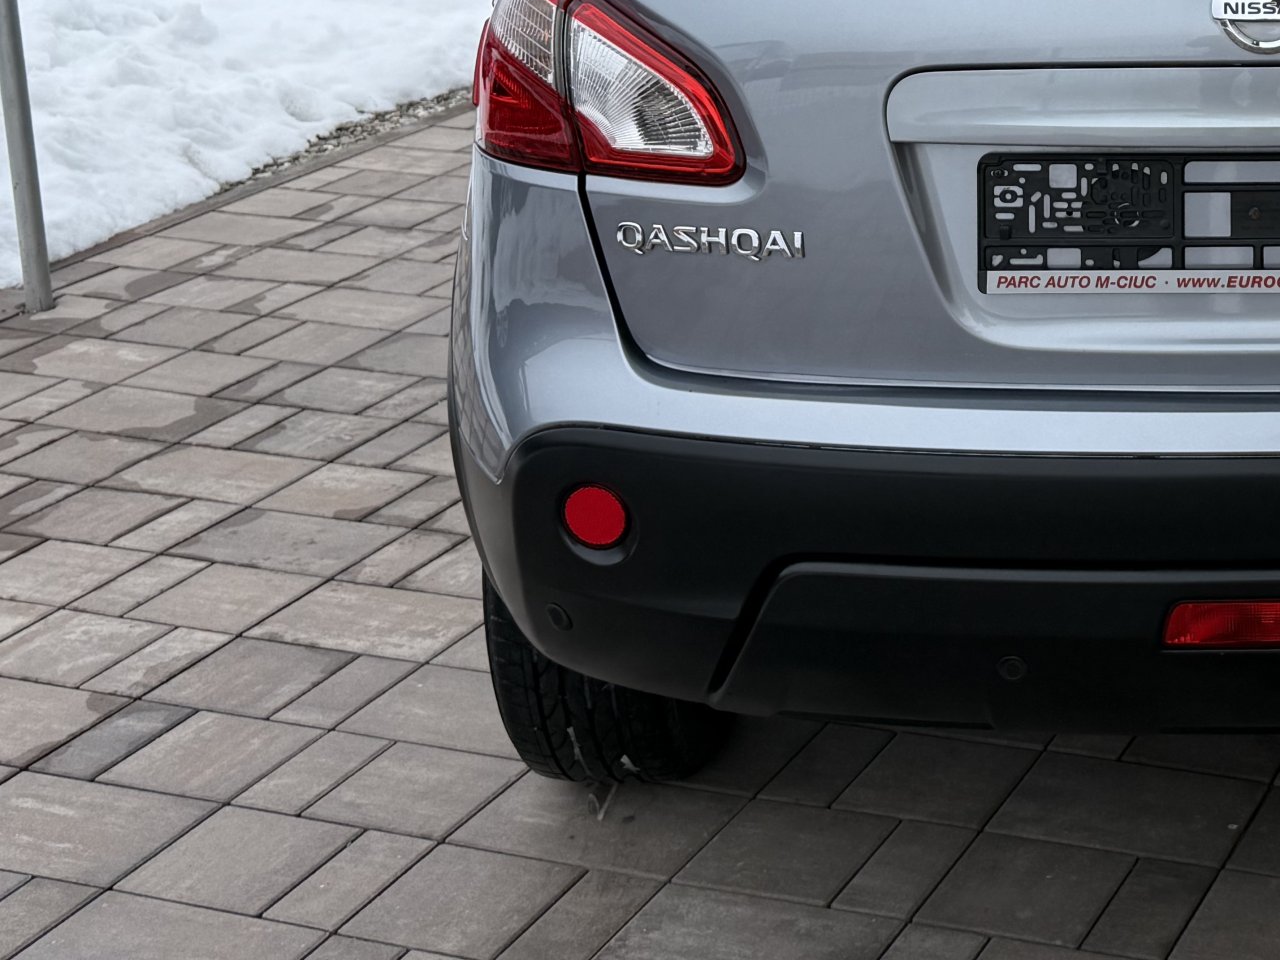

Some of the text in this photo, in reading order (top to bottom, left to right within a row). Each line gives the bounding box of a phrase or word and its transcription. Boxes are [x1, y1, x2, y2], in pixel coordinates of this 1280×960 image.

[616, 221, 805, 261] QASHQAI
[996, 275, 1041, 289] PARC
[1045, 275, 1091, 289] AUTO
[1095, 275, 1157, 289] M-CIUC
